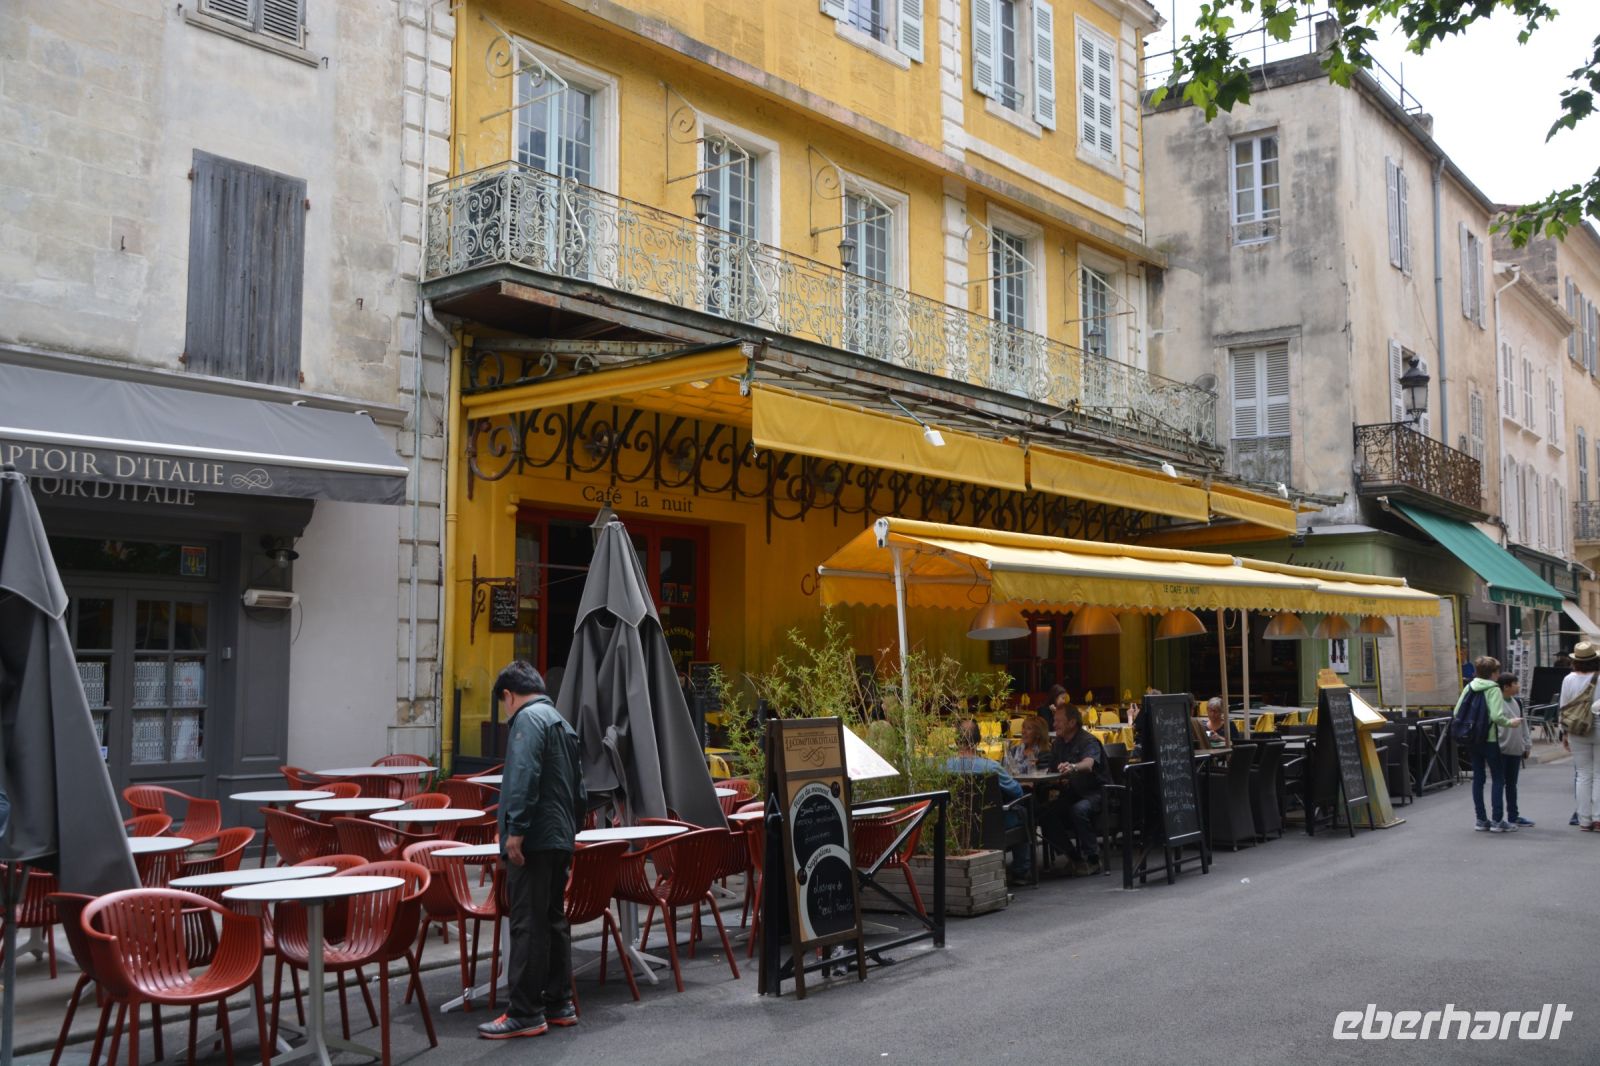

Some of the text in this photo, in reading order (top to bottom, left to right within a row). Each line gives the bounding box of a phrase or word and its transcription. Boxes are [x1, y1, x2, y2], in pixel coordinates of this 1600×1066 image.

[0, 444, 225, 485] PTOIR D'ITALIE
[582, 485, 693, 513] Café la nuit
